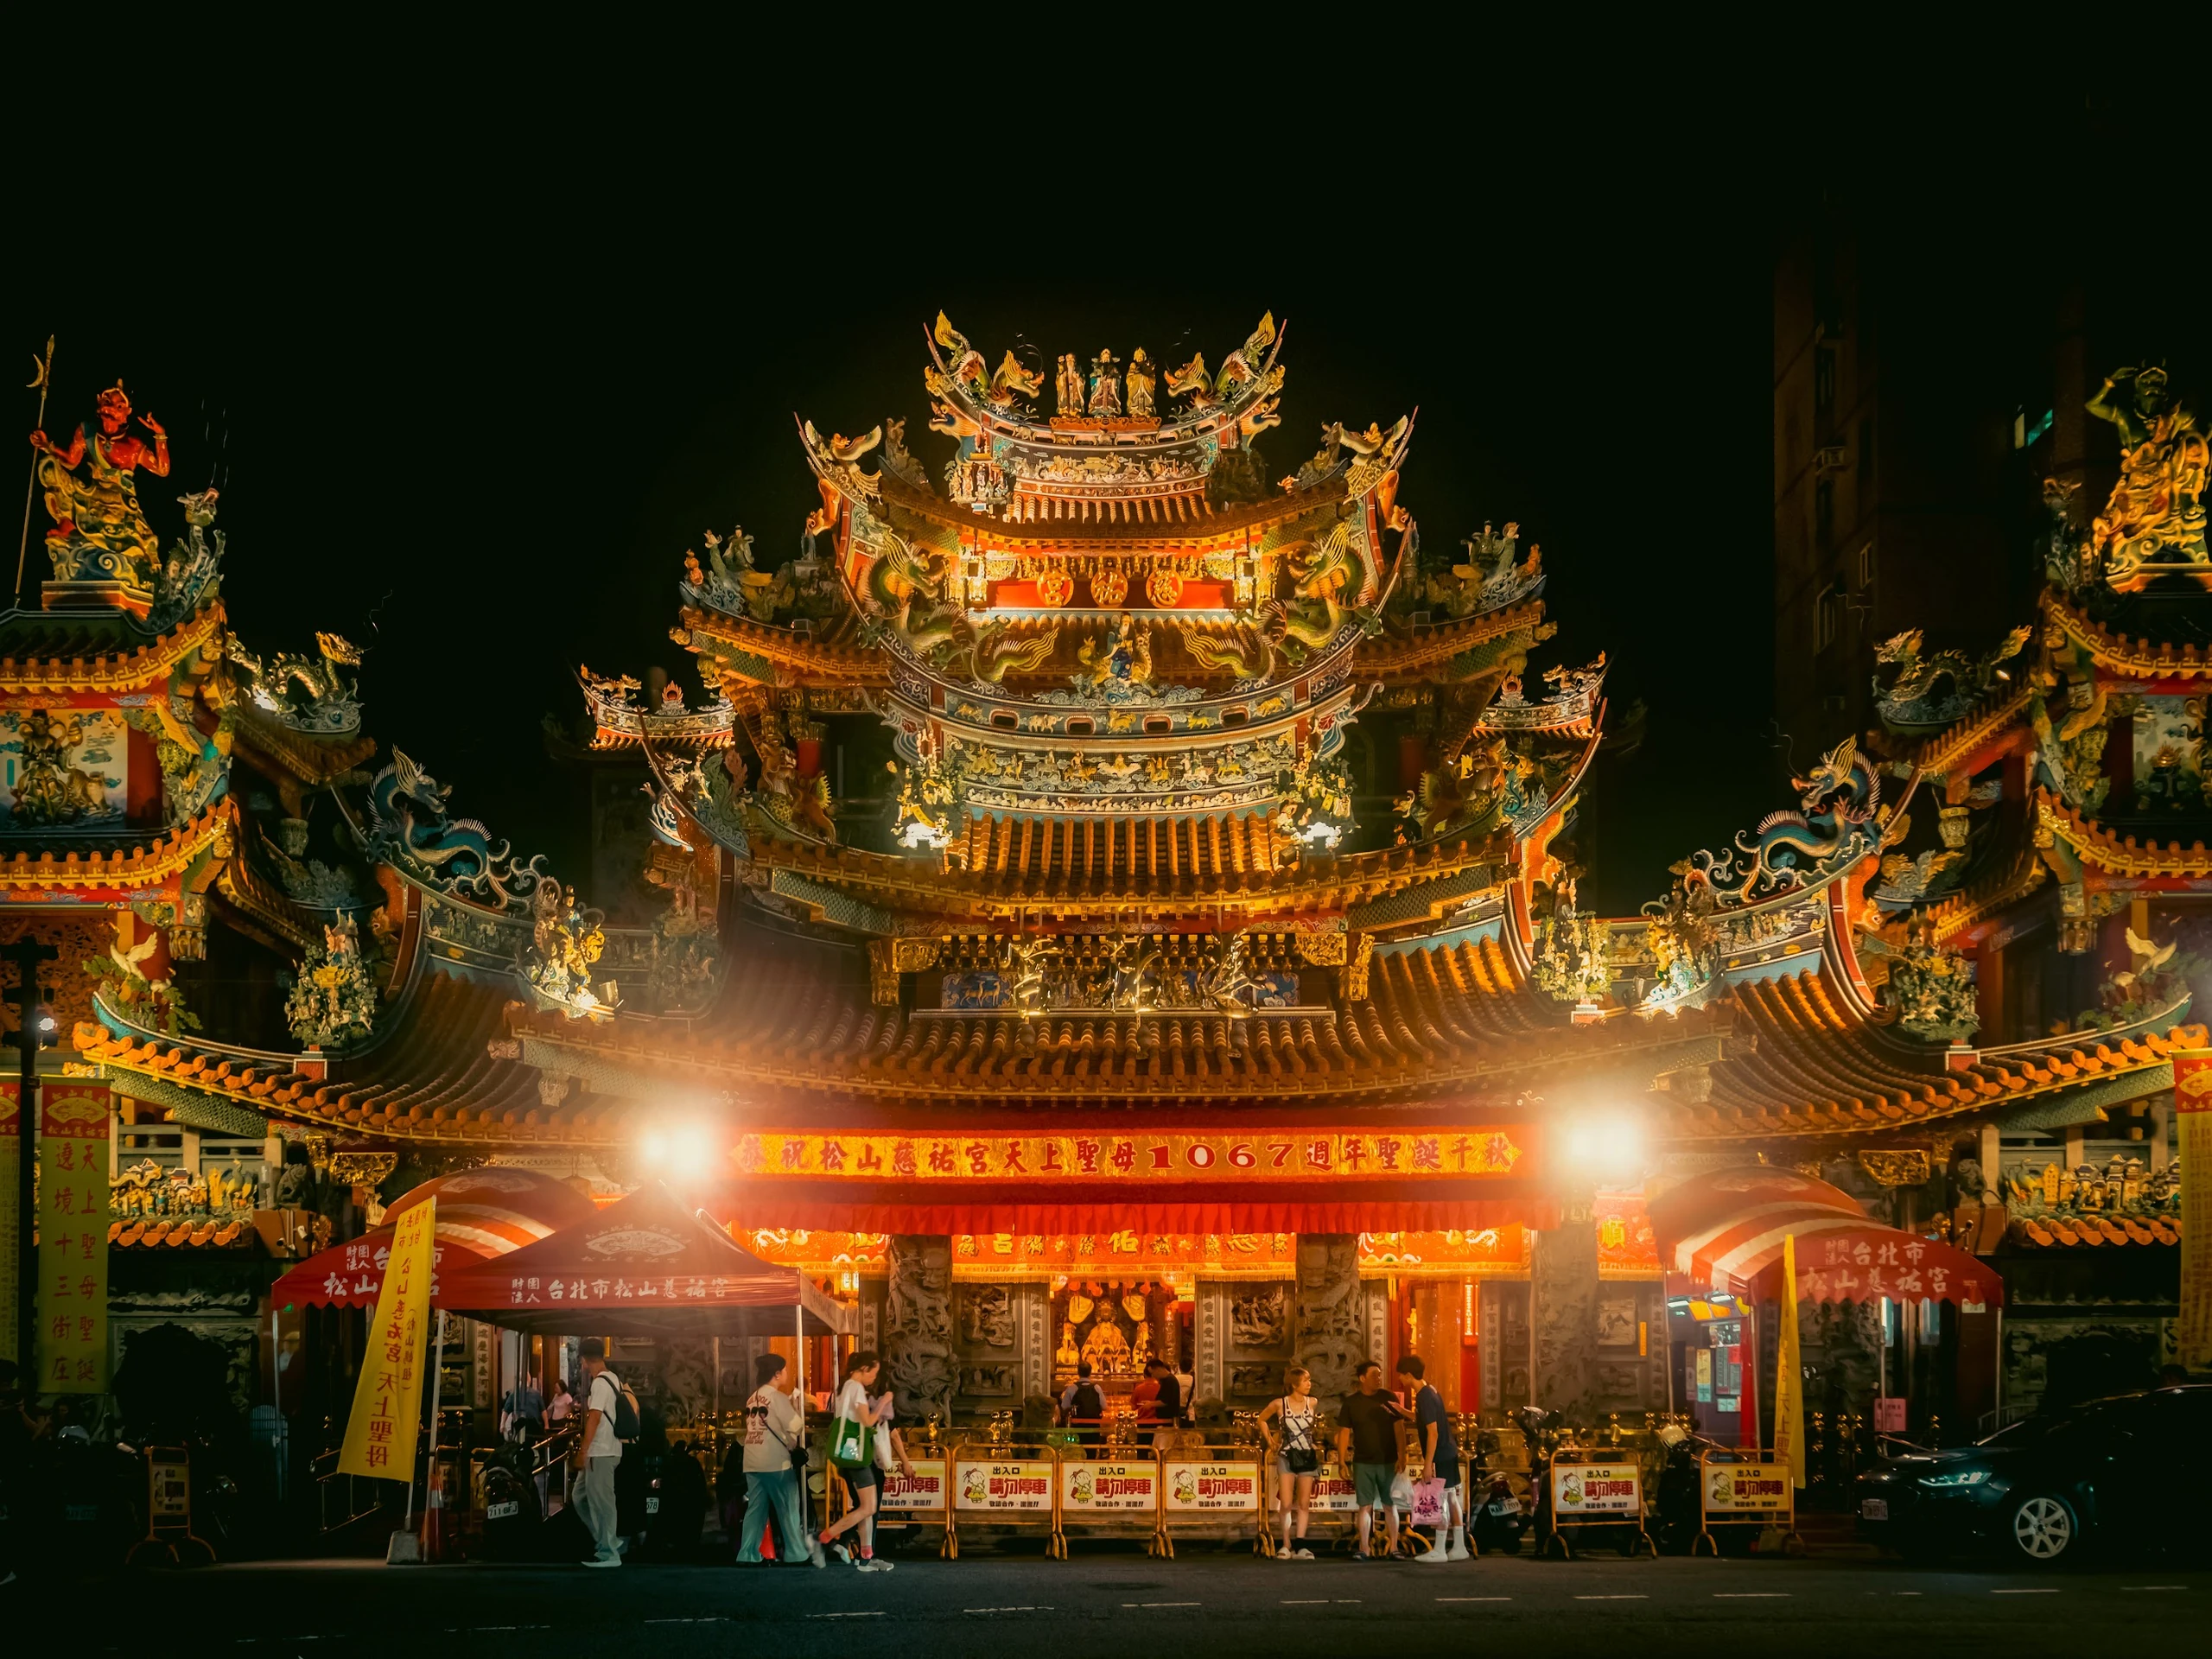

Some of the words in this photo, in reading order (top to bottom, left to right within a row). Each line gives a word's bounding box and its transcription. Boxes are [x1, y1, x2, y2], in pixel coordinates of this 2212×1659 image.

[1853, 1241, 1926, 1265] 台北市
[1802, 1266, 1950, 1294] 松山慈祐宮
[992, 1466, 1020, 1475] 出入口
[1098, 1466, 1126, 1476] 出入口
[1200, 1467, 1227, 1476] 出入口
[1586, 1470, 1611, 1478] 出入口
[1737, 1469, 1760, 1478] 出入口
[988, 1478, 1047, 1498] 請勿停車
[1095, 1478, 1152, 1498] 請勿停車
[1198, 1478, 1252, 1498] 請勿停車
[1311, 1479, 1356, 1499] 勿停車
[1584, 1480, 1634, 1500] 請勿停車
[1734, 1480, 1783, 1499] 請勿停車
